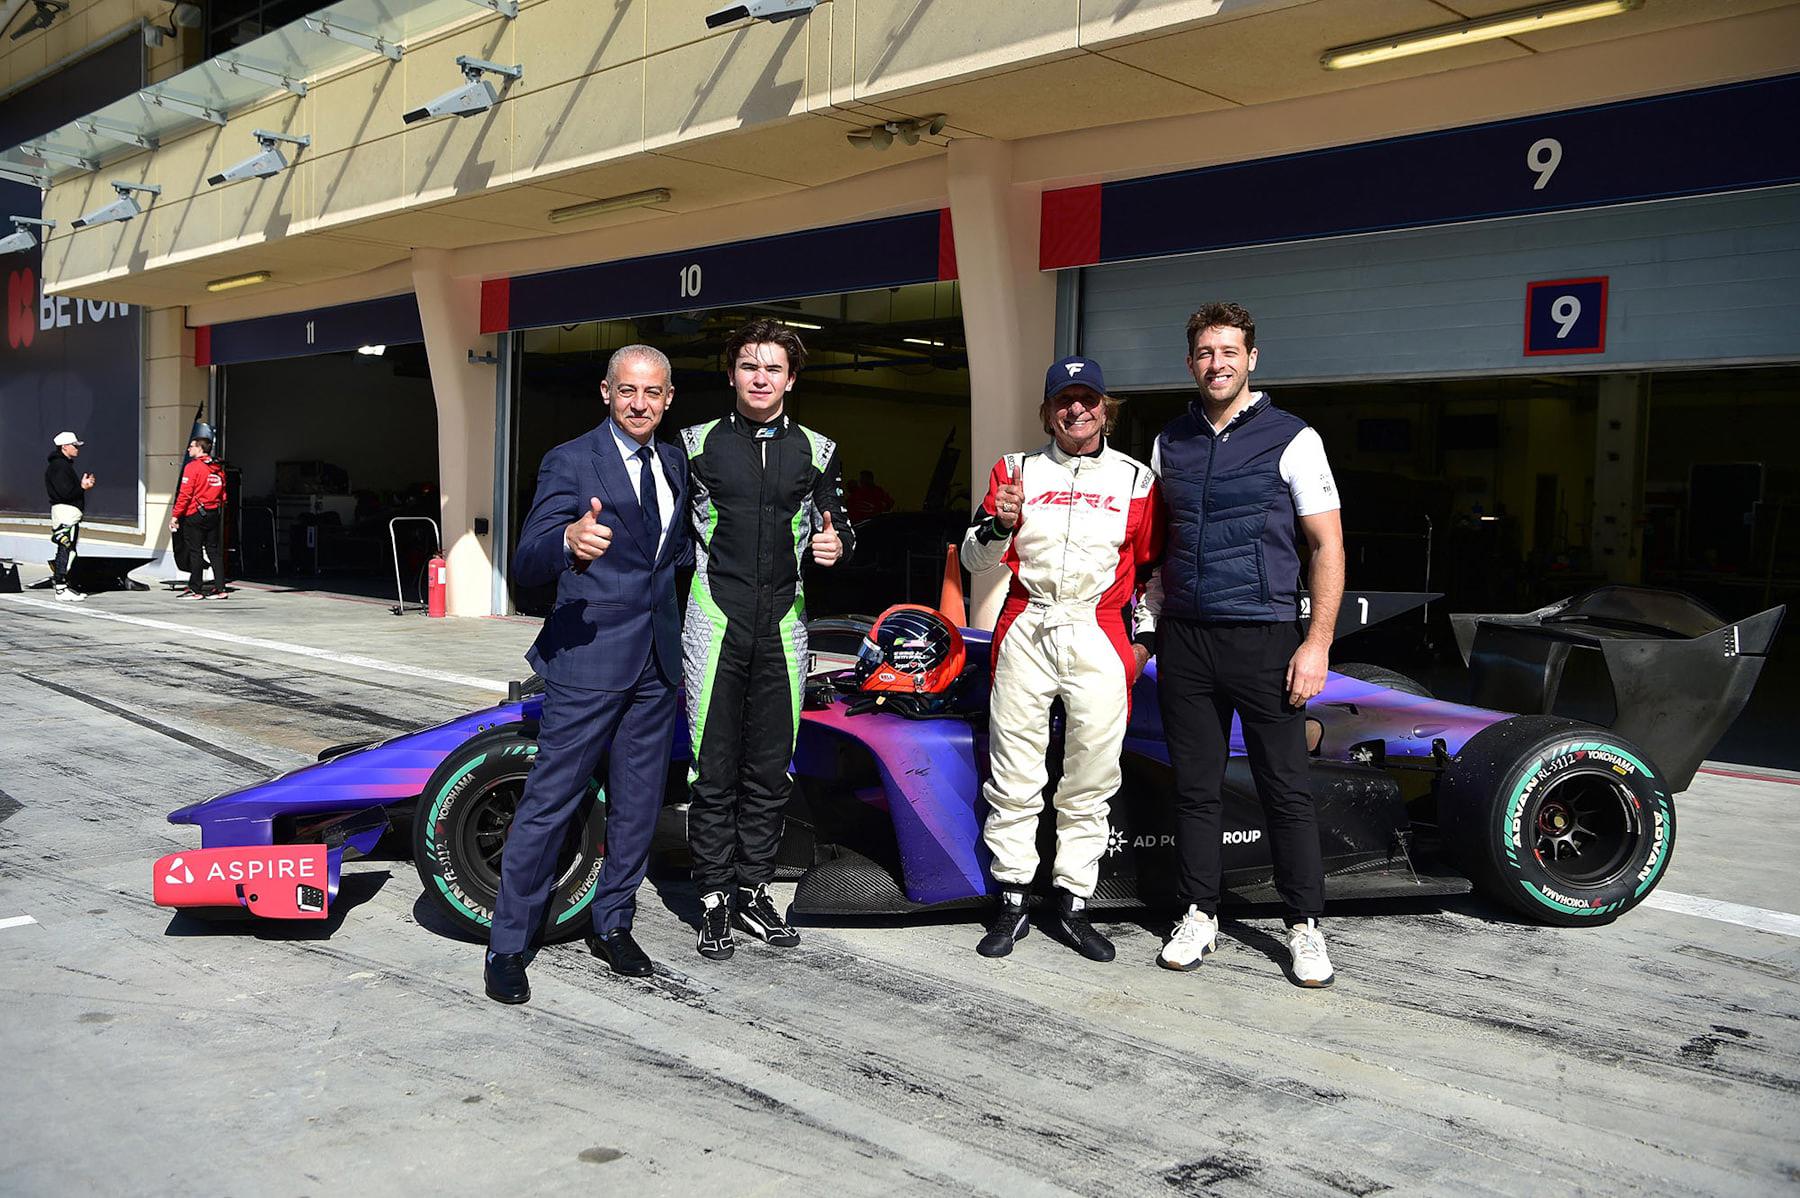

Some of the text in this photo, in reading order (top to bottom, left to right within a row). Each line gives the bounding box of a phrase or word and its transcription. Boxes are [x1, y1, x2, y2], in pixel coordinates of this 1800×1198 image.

[1526, 137, 1563, 190] 9
[680, 264, 702, 297] 10
[40, 285, 129, 331] BEYO
[1551, 295, 1582, 339] 9
[306, 321, 315, 344] 11
[1357, 597, 1369, 625] 1
[1587, 750, 1636, 774] YOKOHAMA
[437, 772, 476, 821] YOKOHAMA
[1512, 776, 1539, 848] ADVAN
[1133, 835, 1156, 848] AD
[1222, 829, 1262, 845] ROUP
[1637, 811, 1664, 882] ADVAN
[206, 858, 315, 881] ASPIRE
[567, 856, 604, 905] YOKOHAMA
[449, 882, 494, 920] VAN
[1541, 885, 1590, 908] YOKOHAMA
